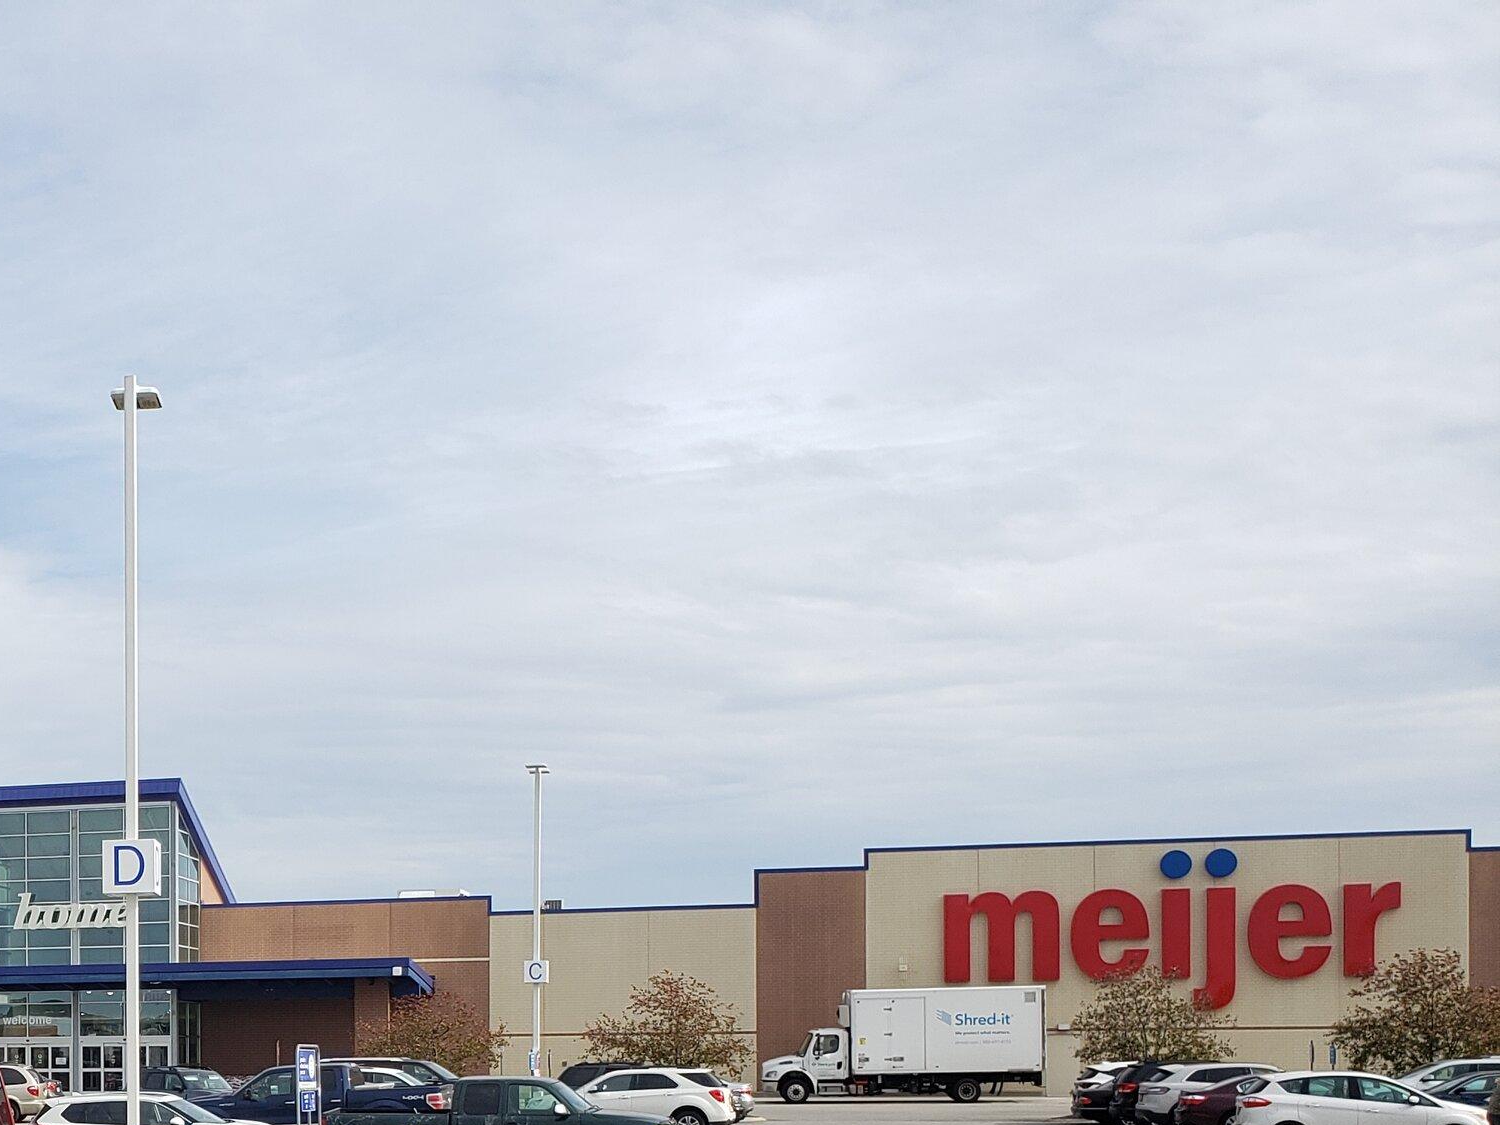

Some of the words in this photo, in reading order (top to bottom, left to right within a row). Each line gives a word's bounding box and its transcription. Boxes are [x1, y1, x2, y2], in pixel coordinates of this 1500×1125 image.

[113, 845, 146, 886] D
[13, 892, 127, 930] home
[943, 848, 1402, 1011] meijer
[529, 962, 543, 980] C
[2, 1016, 52, 1026] welcome
[955, 1012, 1011, 1026] Shred-it
